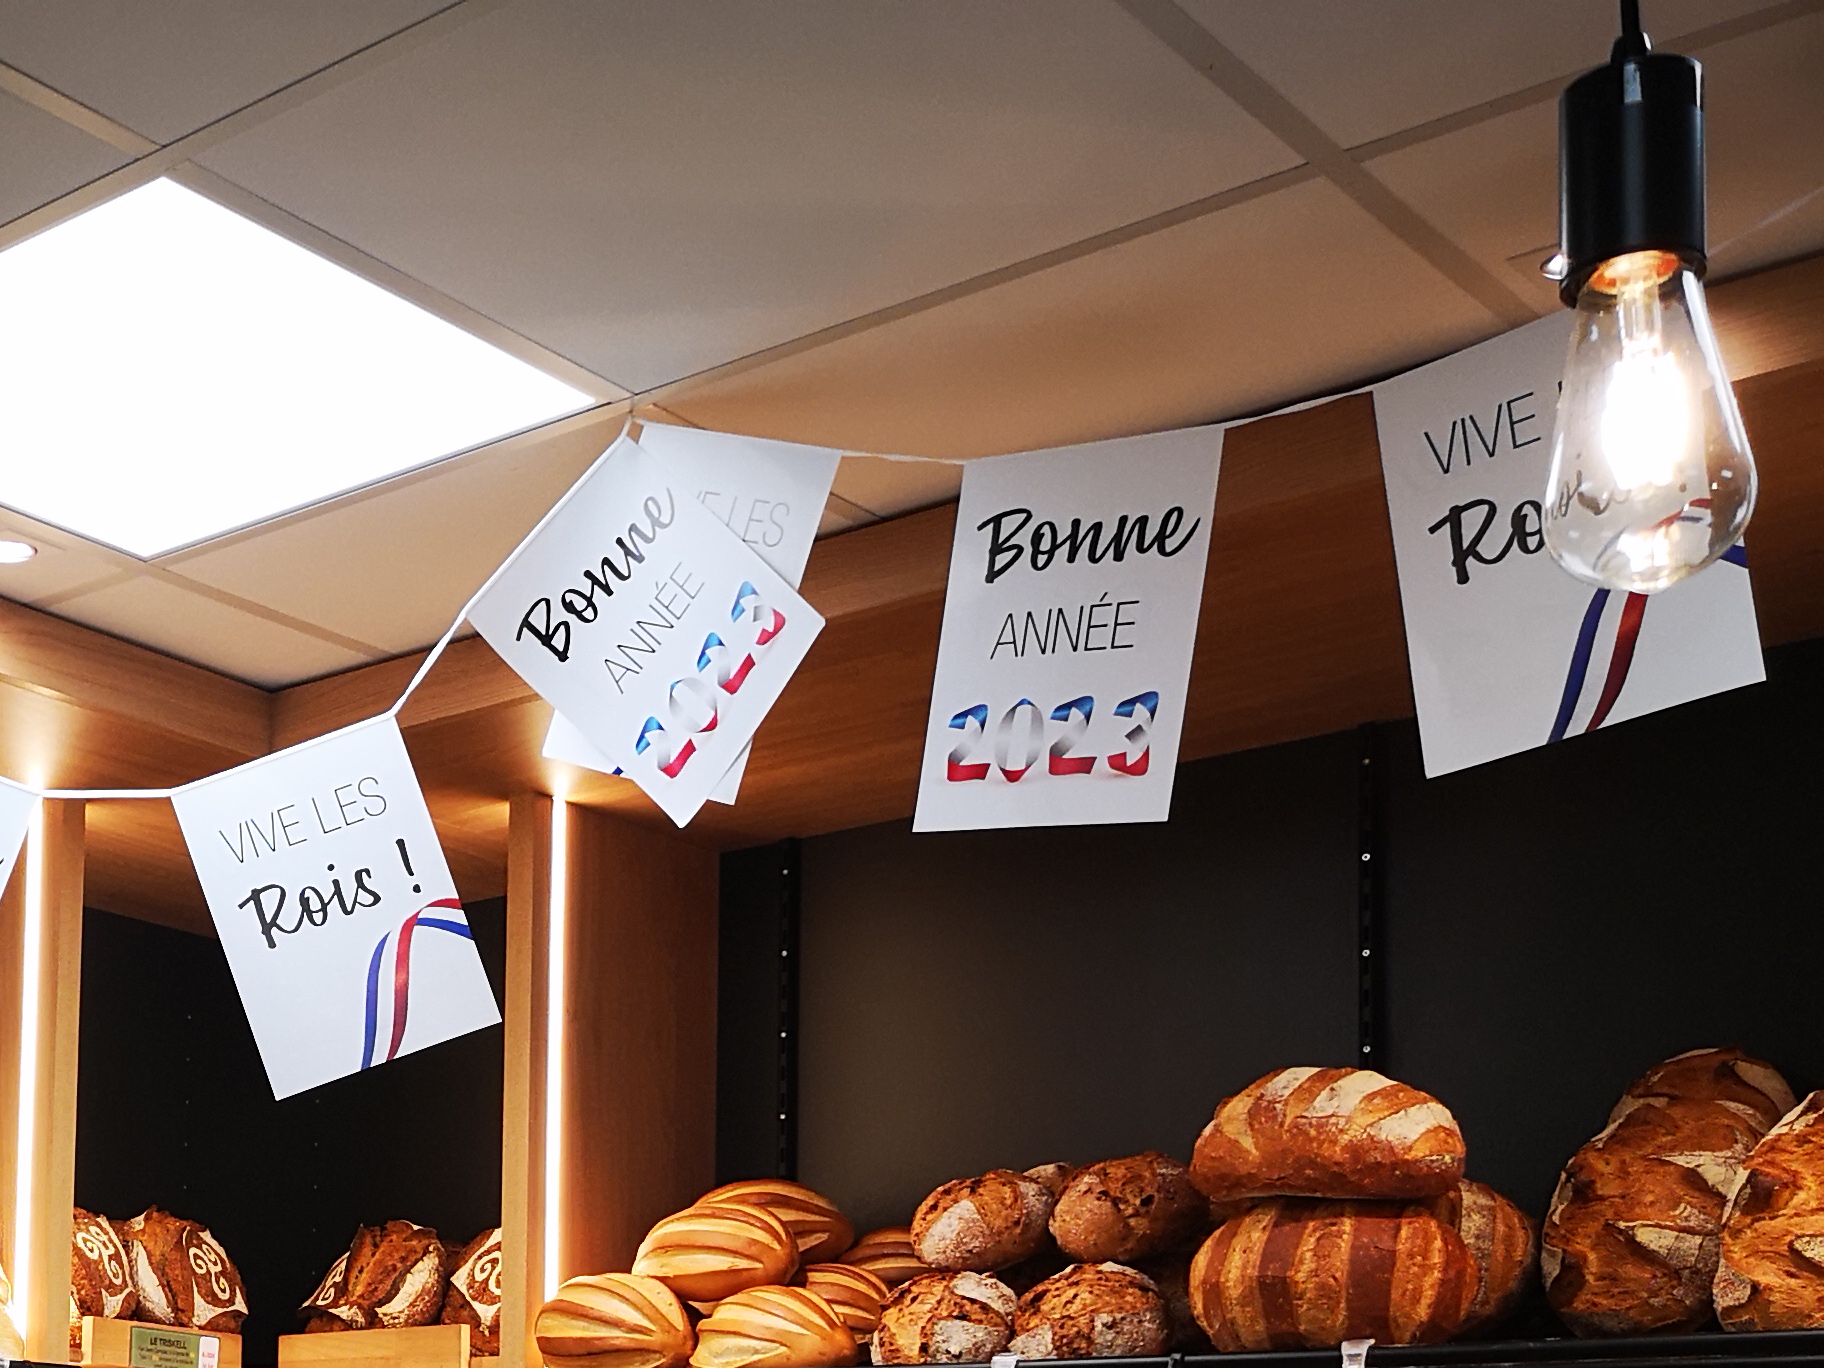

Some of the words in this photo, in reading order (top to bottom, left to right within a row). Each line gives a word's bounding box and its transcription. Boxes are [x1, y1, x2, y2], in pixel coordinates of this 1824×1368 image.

[1424, 392, 1541, 474] VIVE
[516, 488, 675, 662] Bonne
[978, 504, 1201, 585] Bonne
[605, 562, 704, 694] ANNÉE
[988, 596, 1138, 660] ANNÉE
[635, 581, 786, 779] 2023
[947, 690, 1160, 783] 2023
[219, 805, 305, 866] VIVE
[318, 775, 386, 832] LES
[238, 861, 381, 950] Rois
[397, 838, 422, 894] !
